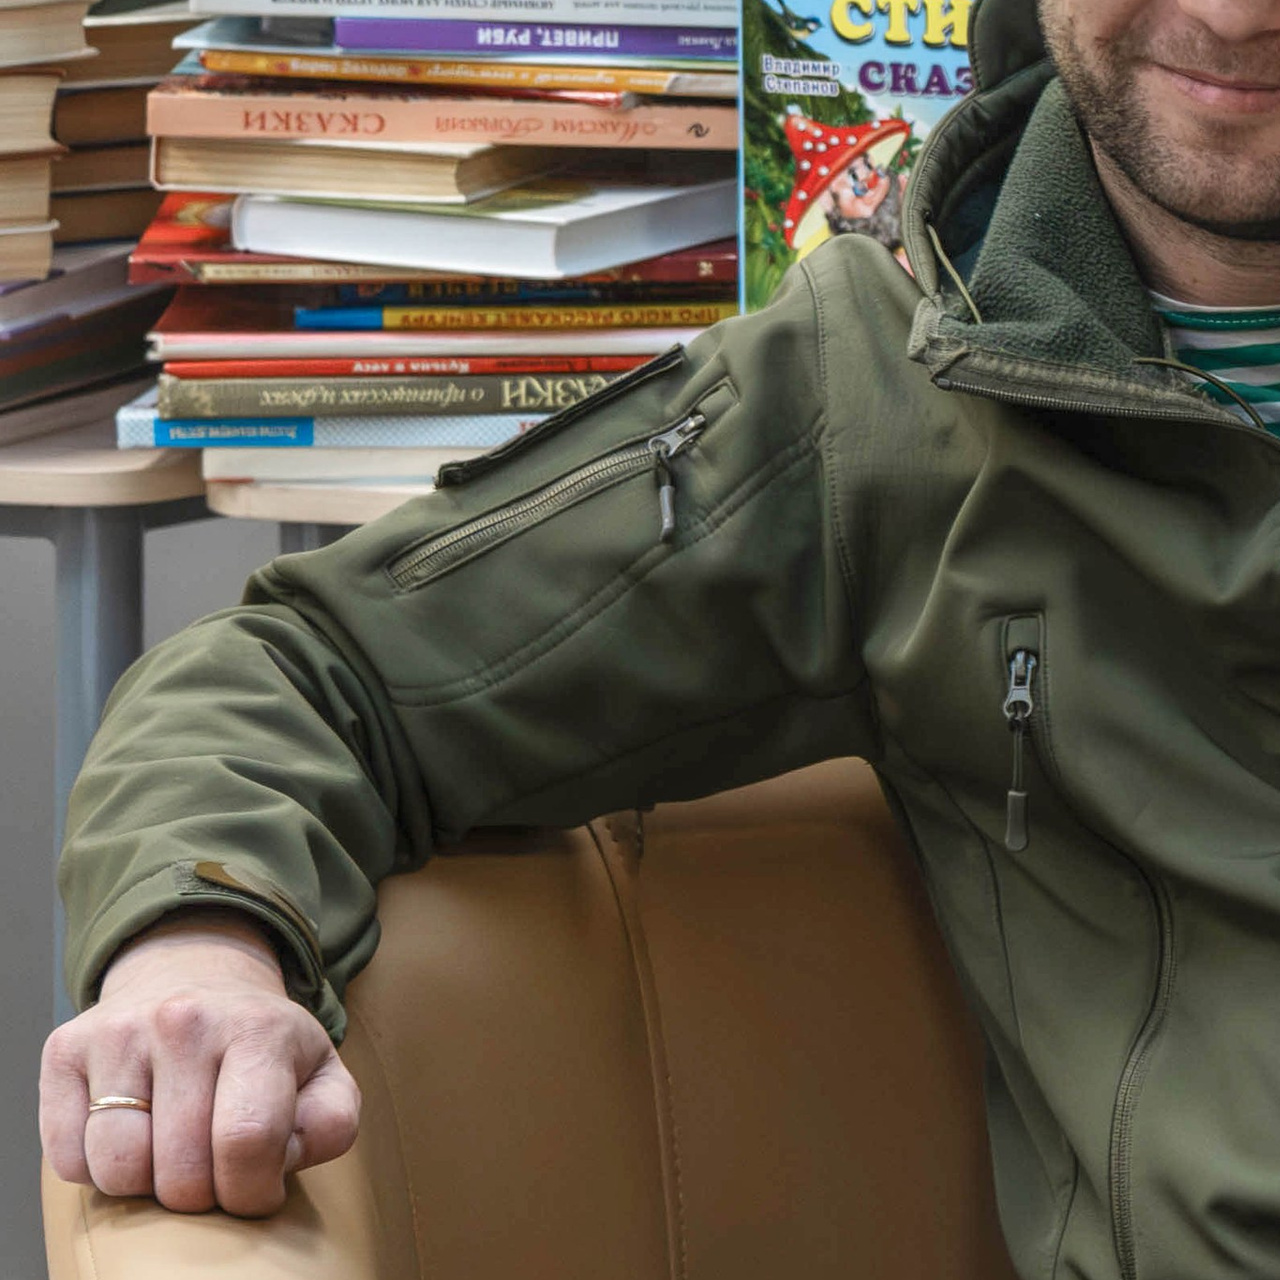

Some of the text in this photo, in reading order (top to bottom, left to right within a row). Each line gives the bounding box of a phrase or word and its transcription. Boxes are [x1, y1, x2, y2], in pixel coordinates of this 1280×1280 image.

[477, 27, 619, 48] ПРИВЕТ, РУБИ
[762, 54, 841, 77] Владимир
[763, 74, 840, 97] Степанов
[858, 60, 975, 96] СКАЗ
[242, 109, 386, 134] СКАЗКИ
[496, 310, 614, 327] РАССКАЖЕТ
[620, 309, 674, 325] КОГО
[679, 308, 720, 323] ПРО
[470, 388, 485, 402] о
[502, 375, 608, 408] АЗКИ
